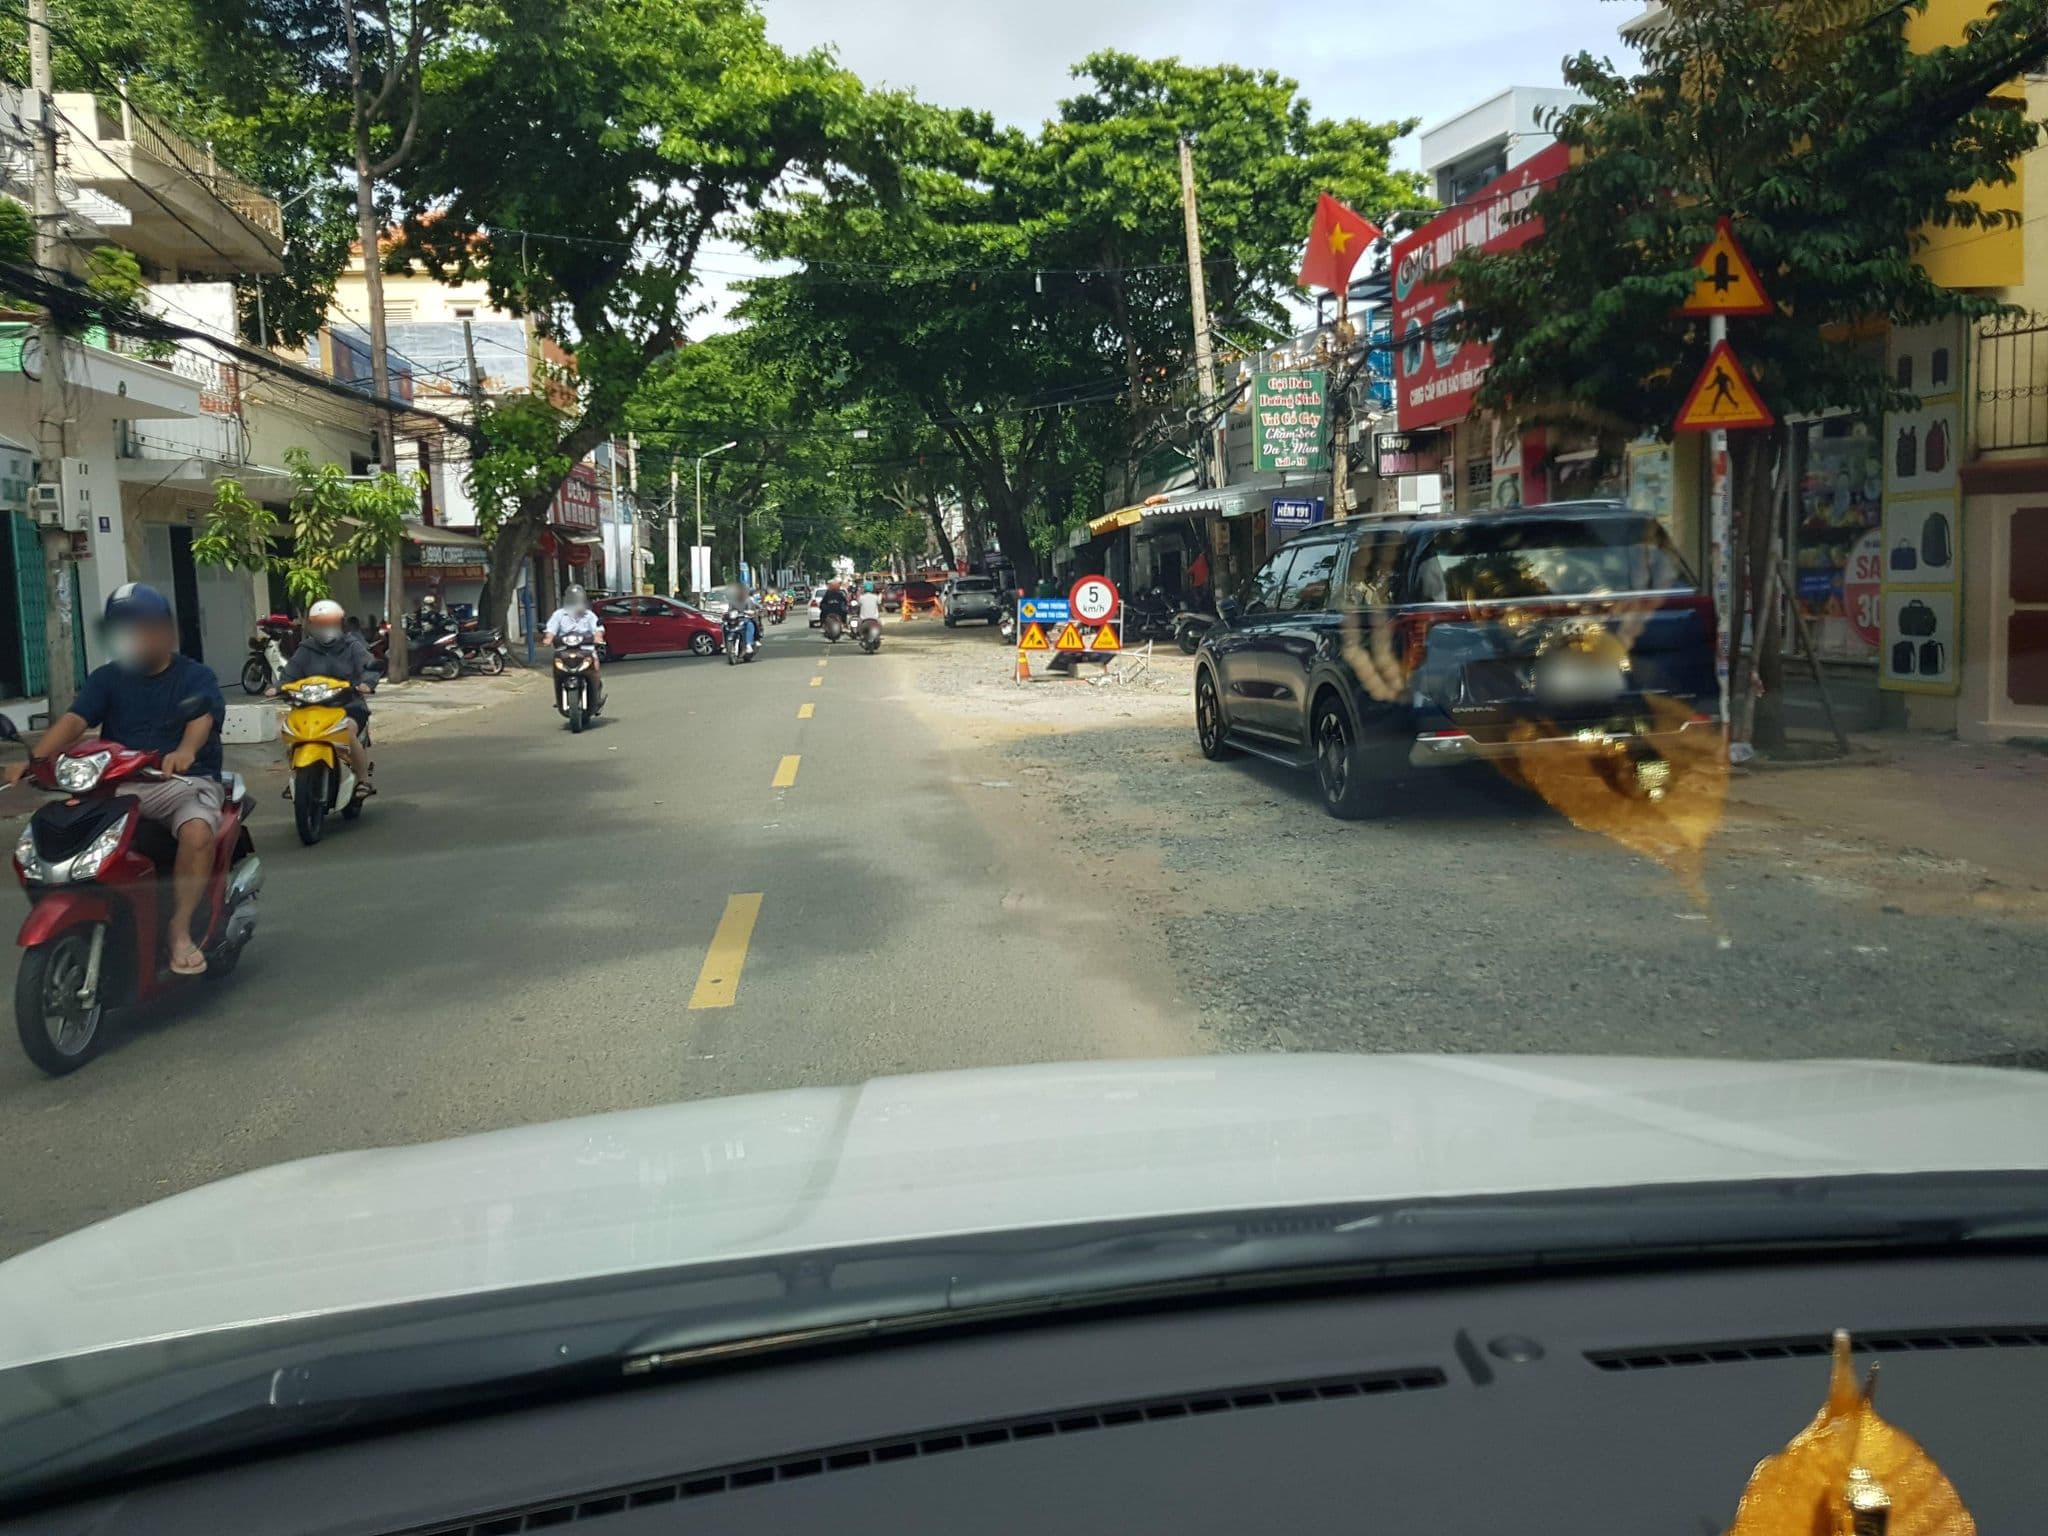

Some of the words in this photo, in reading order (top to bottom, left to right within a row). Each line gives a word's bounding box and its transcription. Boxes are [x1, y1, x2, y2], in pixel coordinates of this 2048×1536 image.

[1380, 437, 1409, 451] Shop
[1296, 505, 1309, 518] 191
[1089, 586, 1098, 603] 5
[1083, 604, 1105, 613] km/h
